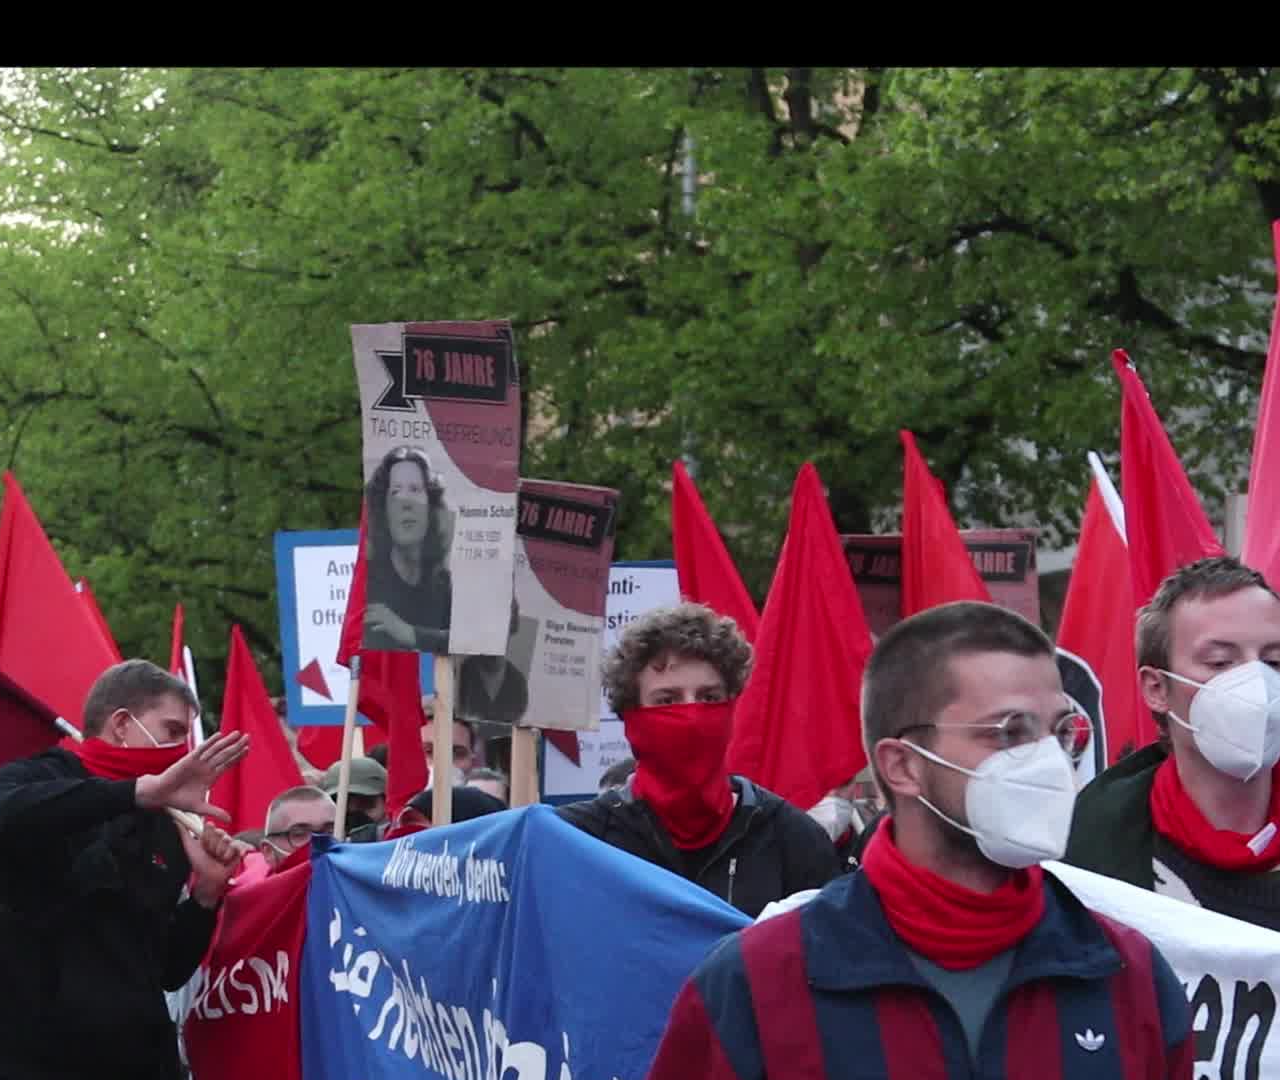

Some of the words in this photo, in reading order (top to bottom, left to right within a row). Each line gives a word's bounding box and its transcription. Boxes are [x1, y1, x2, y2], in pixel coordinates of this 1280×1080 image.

[415, 348, 436, 381] 76
[445, 351, 497, 388] JAHRE
[370, 417, 399, 438] TAG
[401, 419, 432, 440] DER
[520, 502, 540, 526] 76
[545, 507, 596, 539] JAHRE
[413, 839, 464, 907] werden,
[465, 841, 511, 904] denn:
